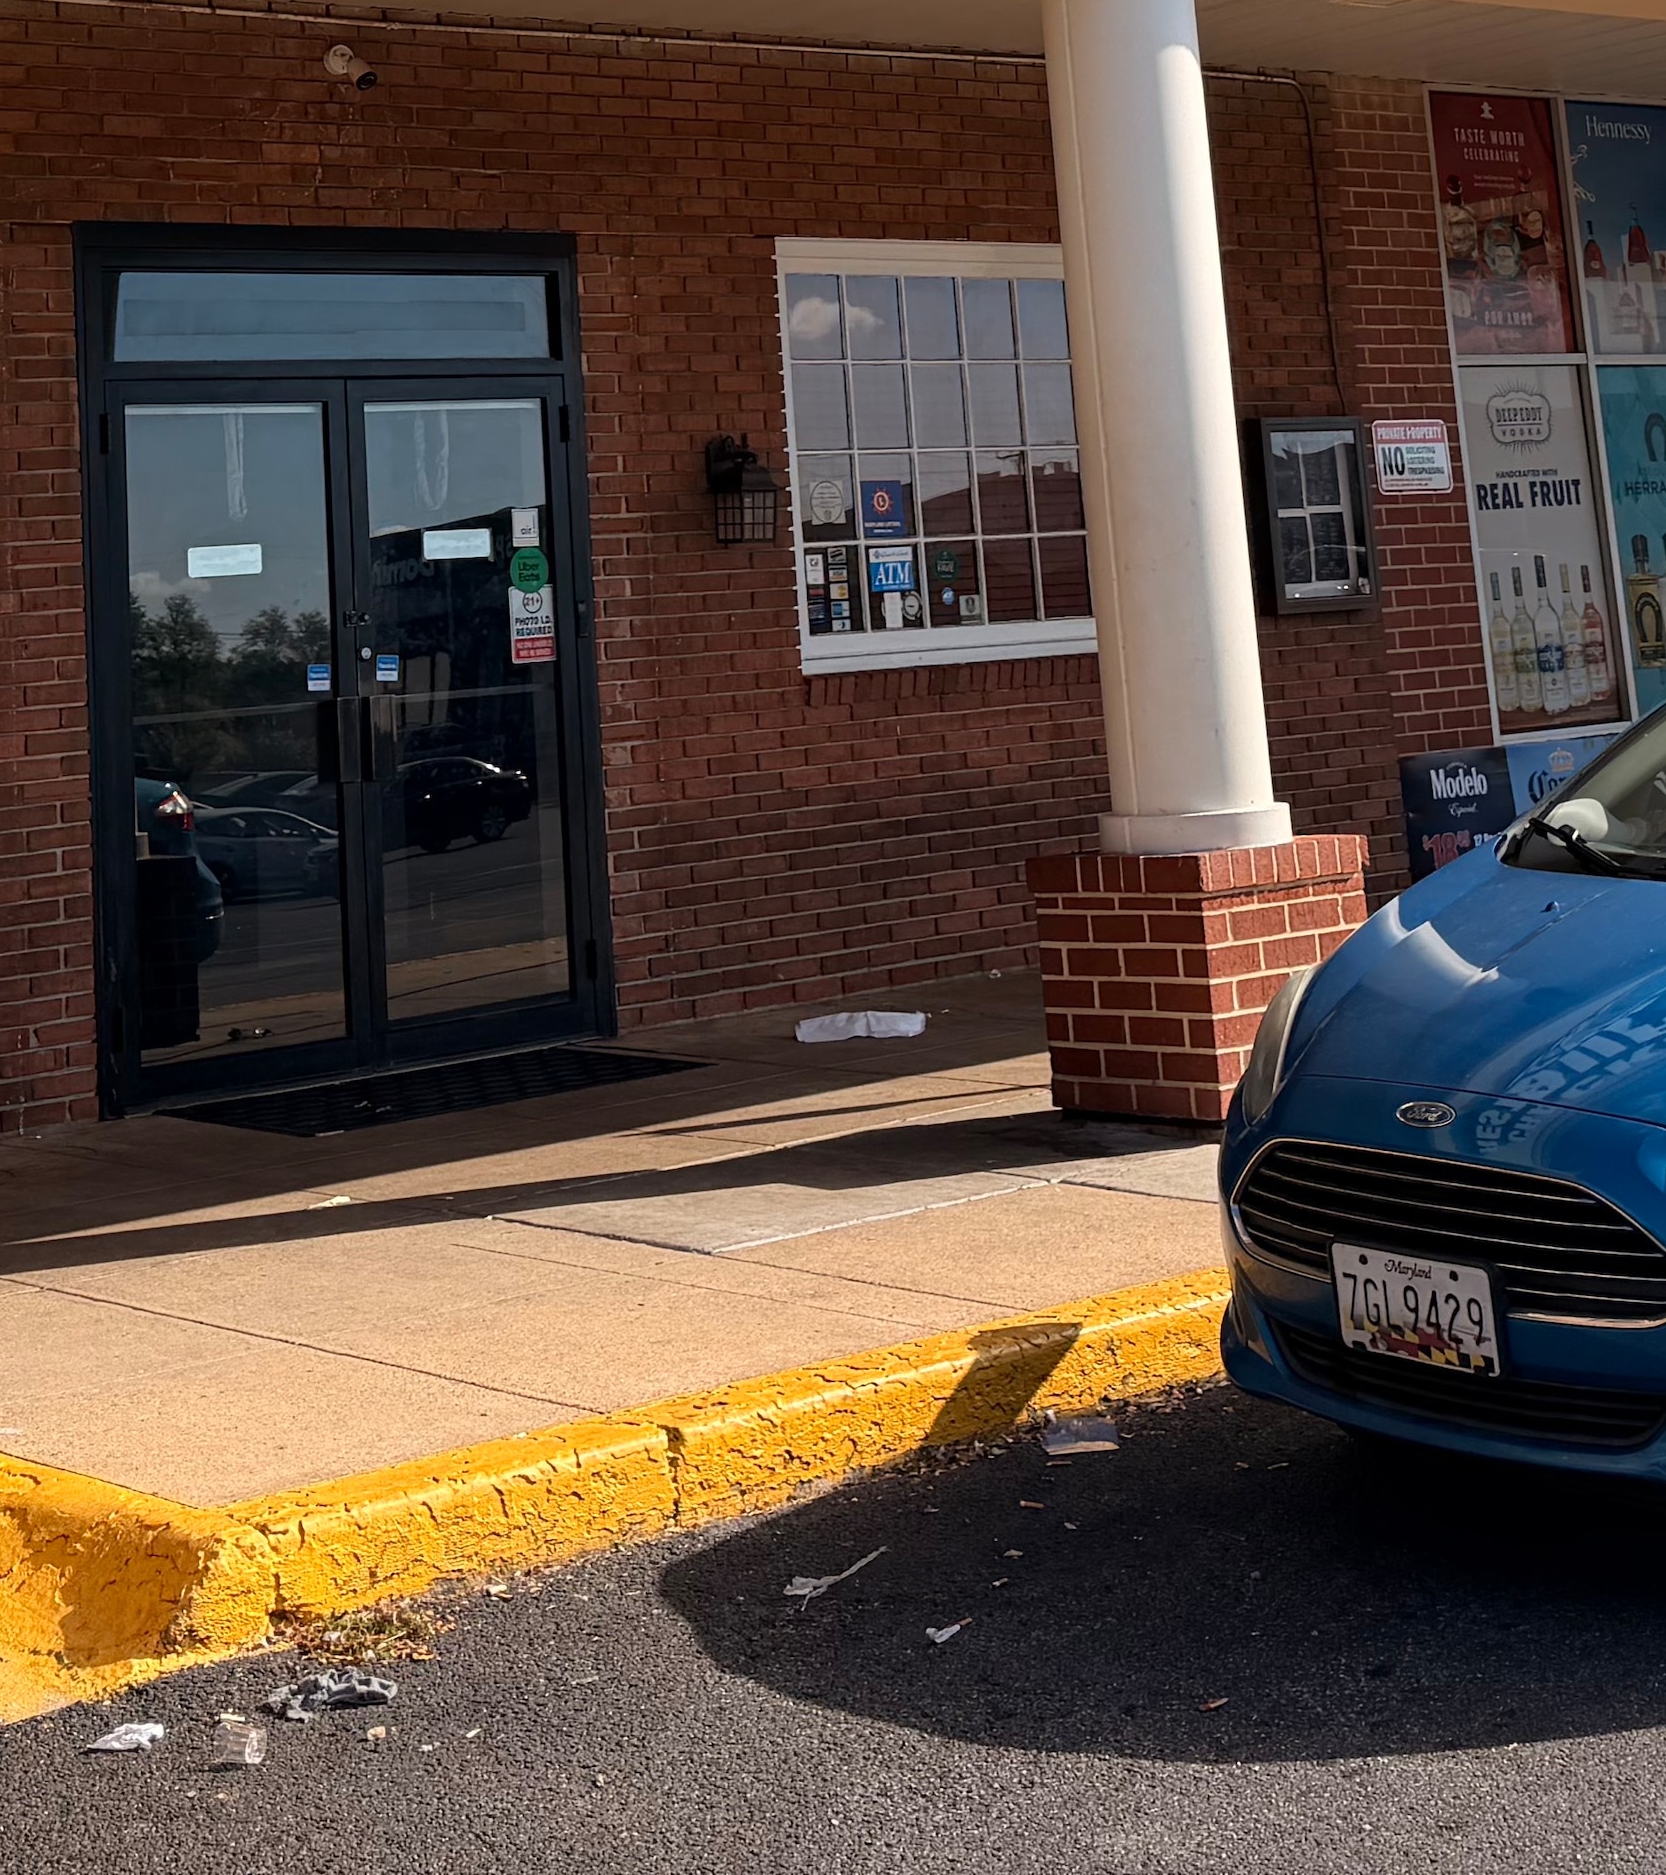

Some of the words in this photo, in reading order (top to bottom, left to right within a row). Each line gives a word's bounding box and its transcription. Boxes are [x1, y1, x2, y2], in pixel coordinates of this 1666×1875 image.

[1454, 127, 1486, 145] TASTE
[1489, 129, 1526, 147] WORTH
[1585, 115, 1652, 145] Hennessy
[1463, 147, 1520, 163] CELEBRATING
[1377, 426, 1406, 440] PRIVATE
[1406, 426, 1442, 440] PROPERTY
[1501, 427, 1542, 438] VODKA
[1381, 446, 1405, 476] NO
[1476, 481, 1524, 511] REAL
[1528, 479, 1582, 508] FRUIT
[874, 562, 911, 586] ATM
[515, 616, 540, 626] PHOTO
[516, 626, 552, 637] REQUIRED
[1429, 766, 1488, 801] Modelo
[1406, 1107, 1441, 1123] Ford
[1384, 1258, 1432, 1281] Maryland
[1343, 1271, 1484, 1347] 7GL9429
